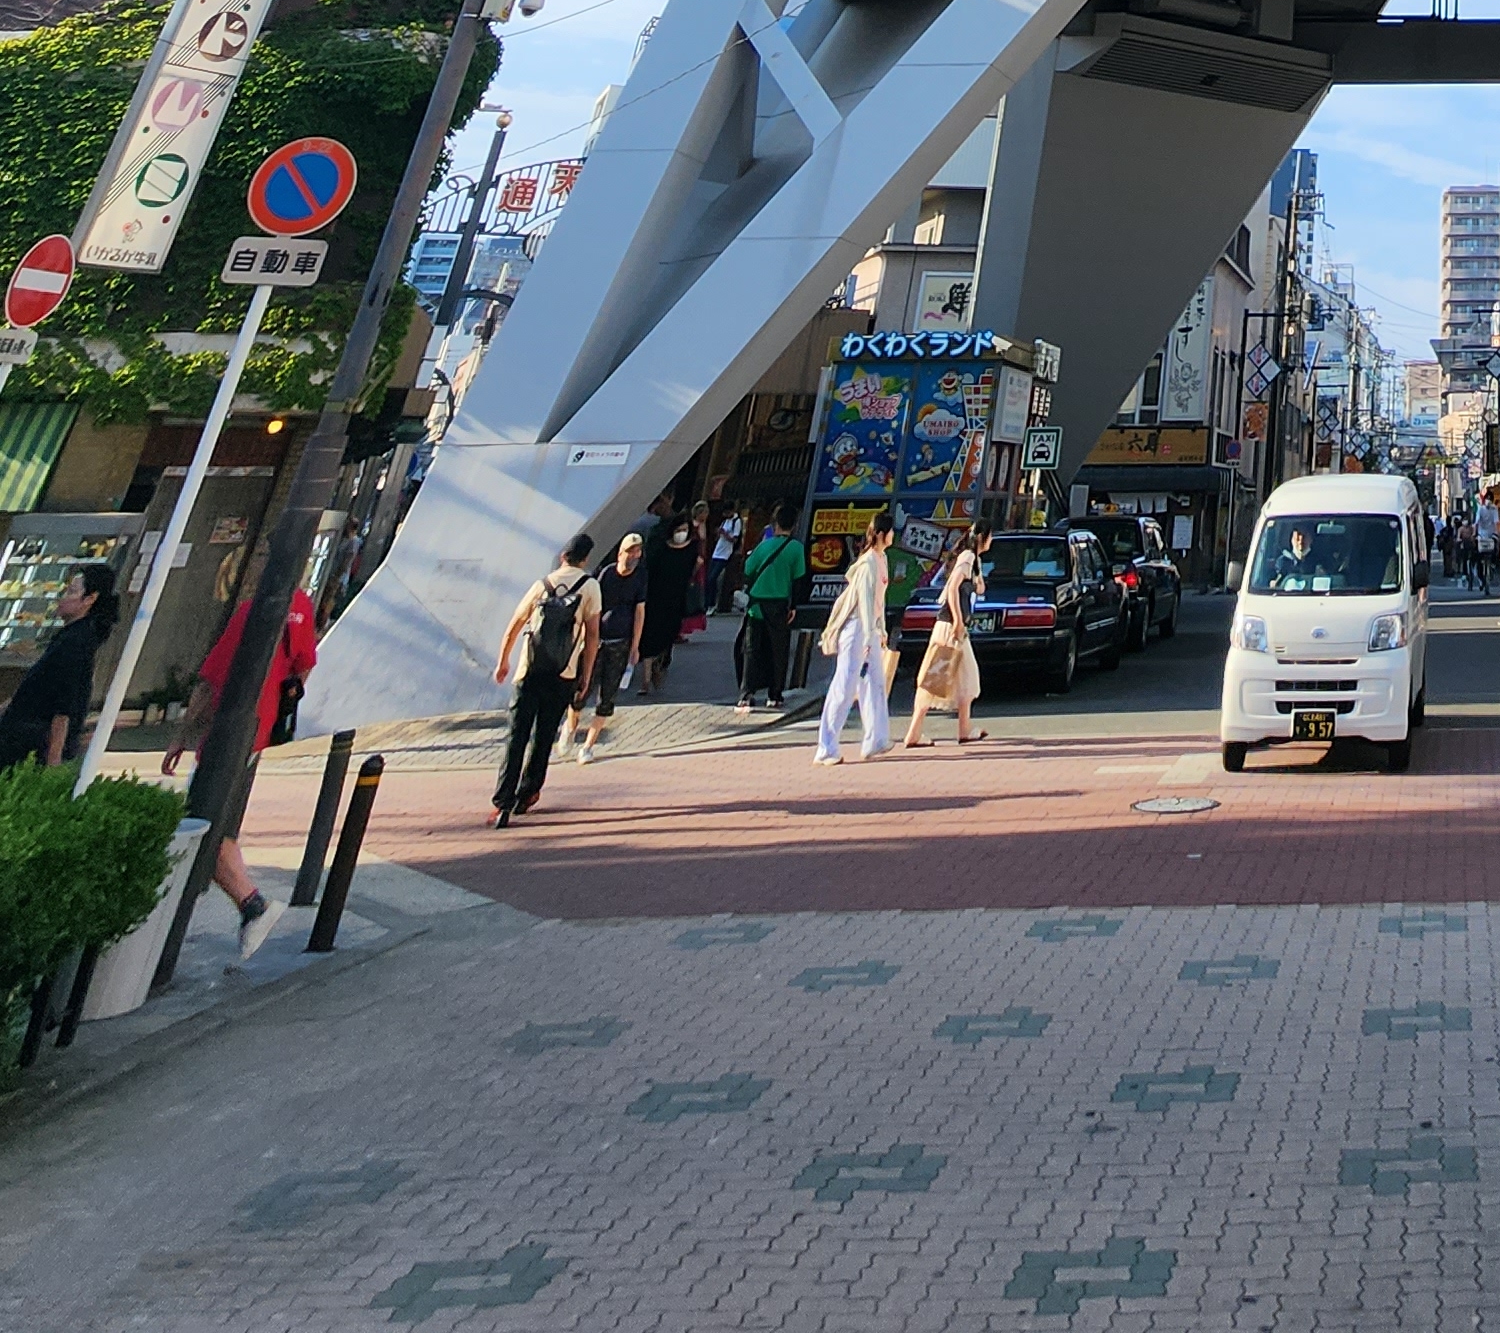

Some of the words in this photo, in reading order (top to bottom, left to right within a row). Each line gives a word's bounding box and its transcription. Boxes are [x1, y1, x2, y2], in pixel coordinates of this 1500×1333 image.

[230, 248, 321, 275] 自動車
[841, 332, 992, 357] わくわくランド
[1032, 434, 1055, 443] TAXI
